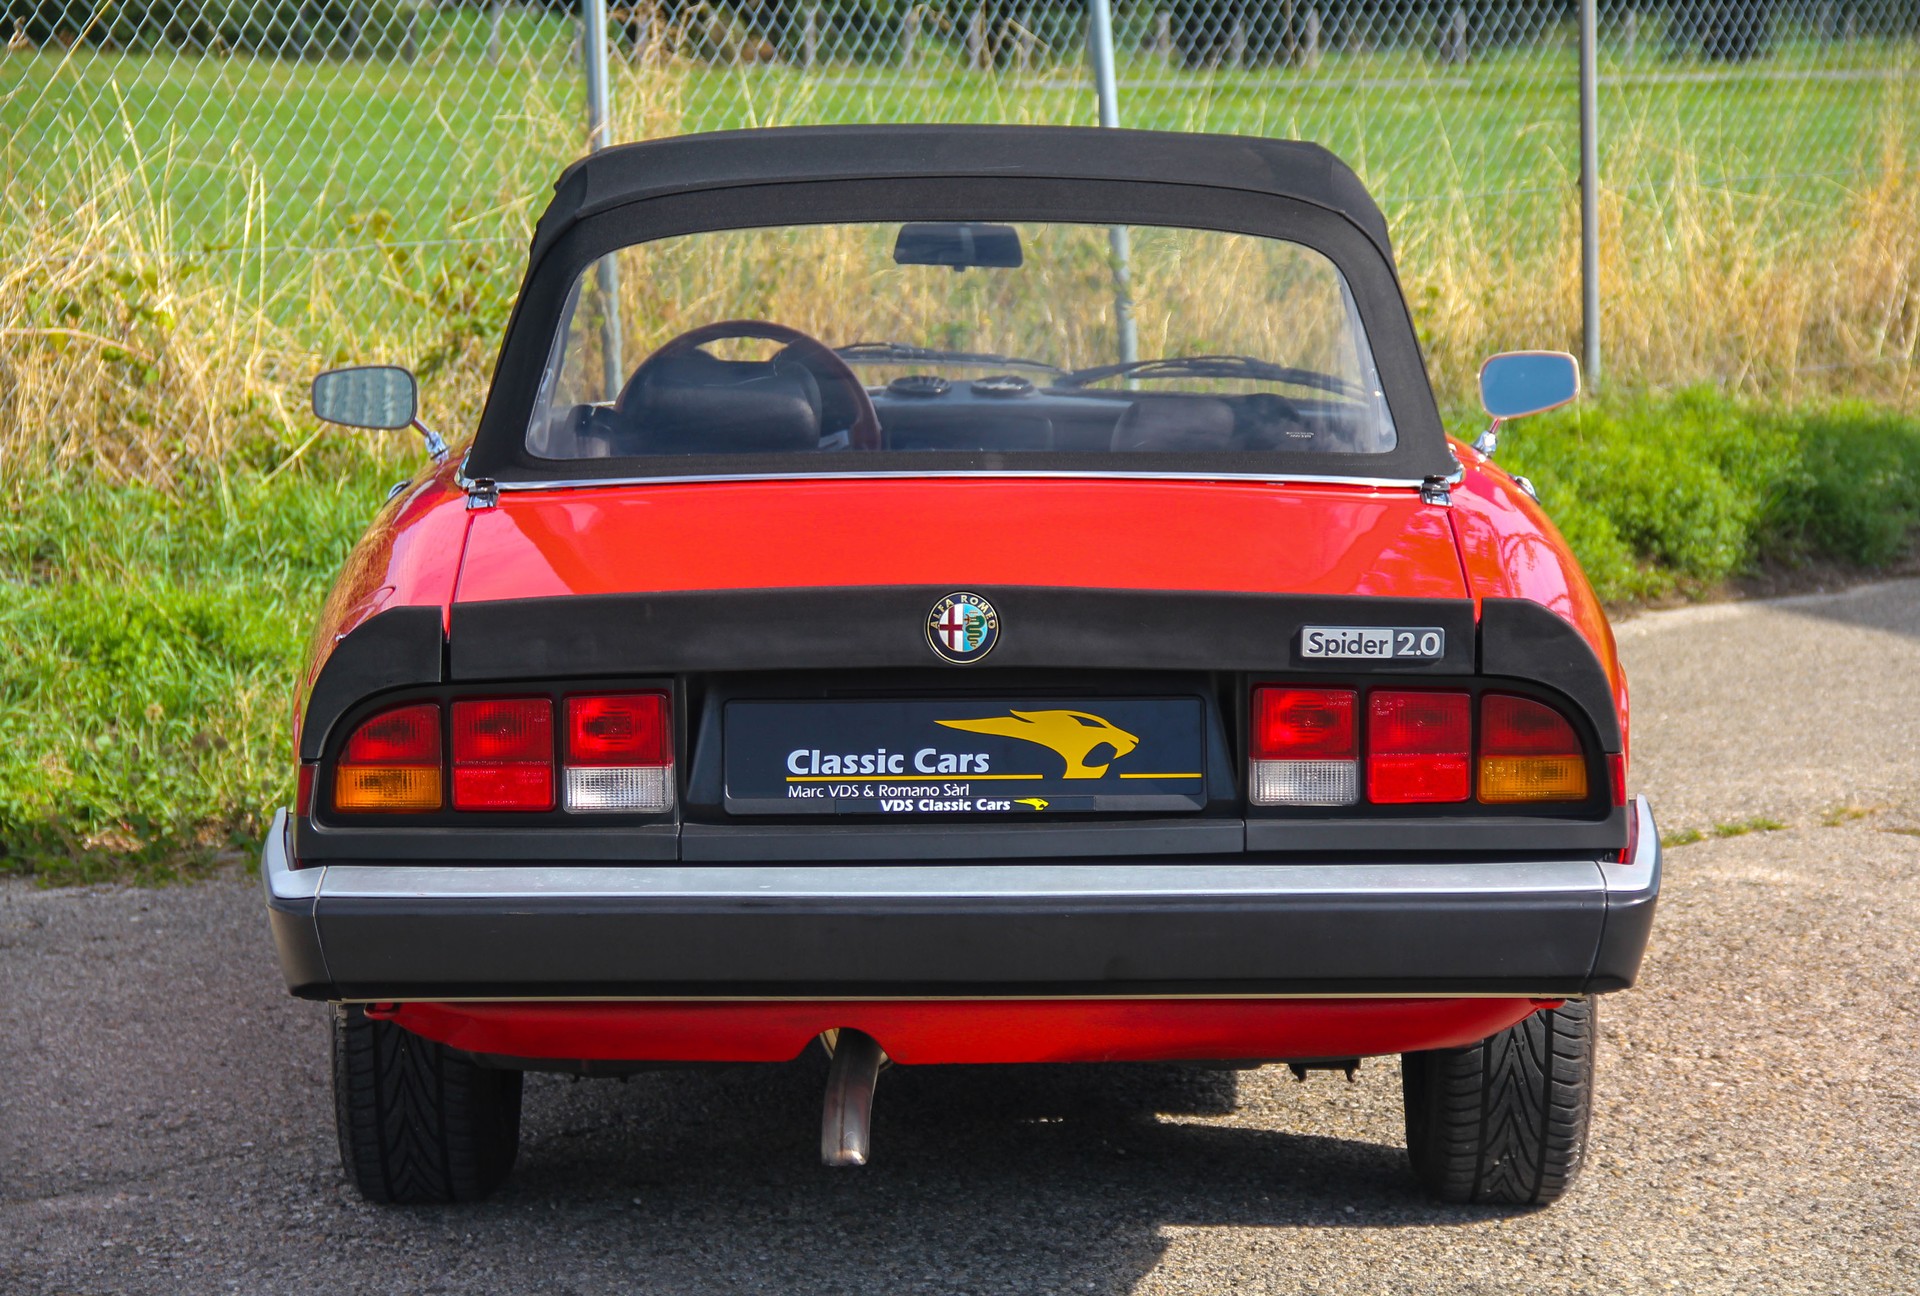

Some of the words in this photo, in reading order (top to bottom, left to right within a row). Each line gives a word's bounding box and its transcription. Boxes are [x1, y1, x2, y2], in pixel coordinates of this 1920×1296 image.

[930, 598, 954, 630] ALFA
[960, 595, 996, 630] ROMEO
[1309, 632, 1389, 656] Spider
[1397, 632, 1441, 656] 2.0
[787, 748, 905, 775] Classic
[914, 748, 990, 774] Cars
[788, 785, 825, 798] Marc
[828, 785, 860, 798] VDS
[863, 784, 875, 798] &
[879, 784, 940, 798] Romano
[943, 783, 970, 797] Sàrl
[880, 799, 914, 812] VDS
[918, 799, 972, 812] Classic
[976, 798, 1011, 811] Cars
